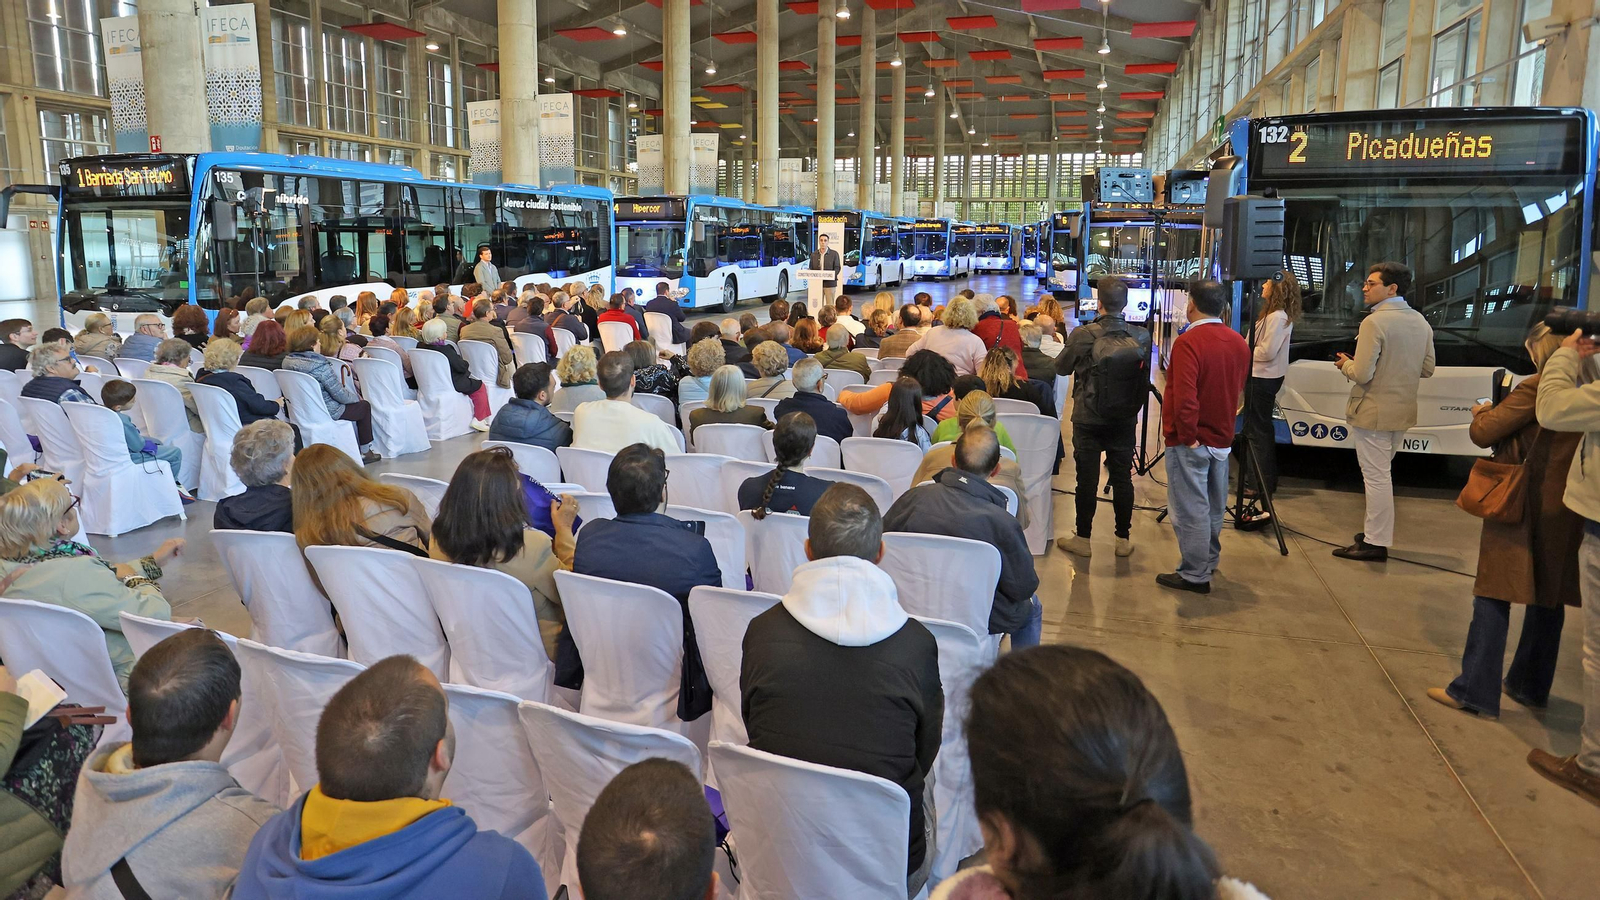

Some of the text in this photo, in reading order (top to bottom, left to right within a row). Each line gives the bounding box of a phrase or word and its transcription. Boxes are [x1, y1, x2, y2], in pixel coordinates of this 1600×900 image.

[206, 17, 250, 32] IFECA
[540, 101, 570, 111] IFECA
[470, 108, 499, 118] IFECA
[1259, 126, 1287, 144] 132
[1288, 131, 1493, 163] 2 Picadueñas
[59, 164, 71, 175] 135
[85, 168, 125, 187] Barriada
[124, 167, 142, 185] San
[142, 167, 173, 184] Telmo
[214, 171, 234, 183] 135
[504, 198, 582, 212] Jerez ciudad sostenible
[632, 204, 661, 213] Hipercor
[1061, 216, 1068, 225] 6
[1402, 438, 1429, 451] NGV
